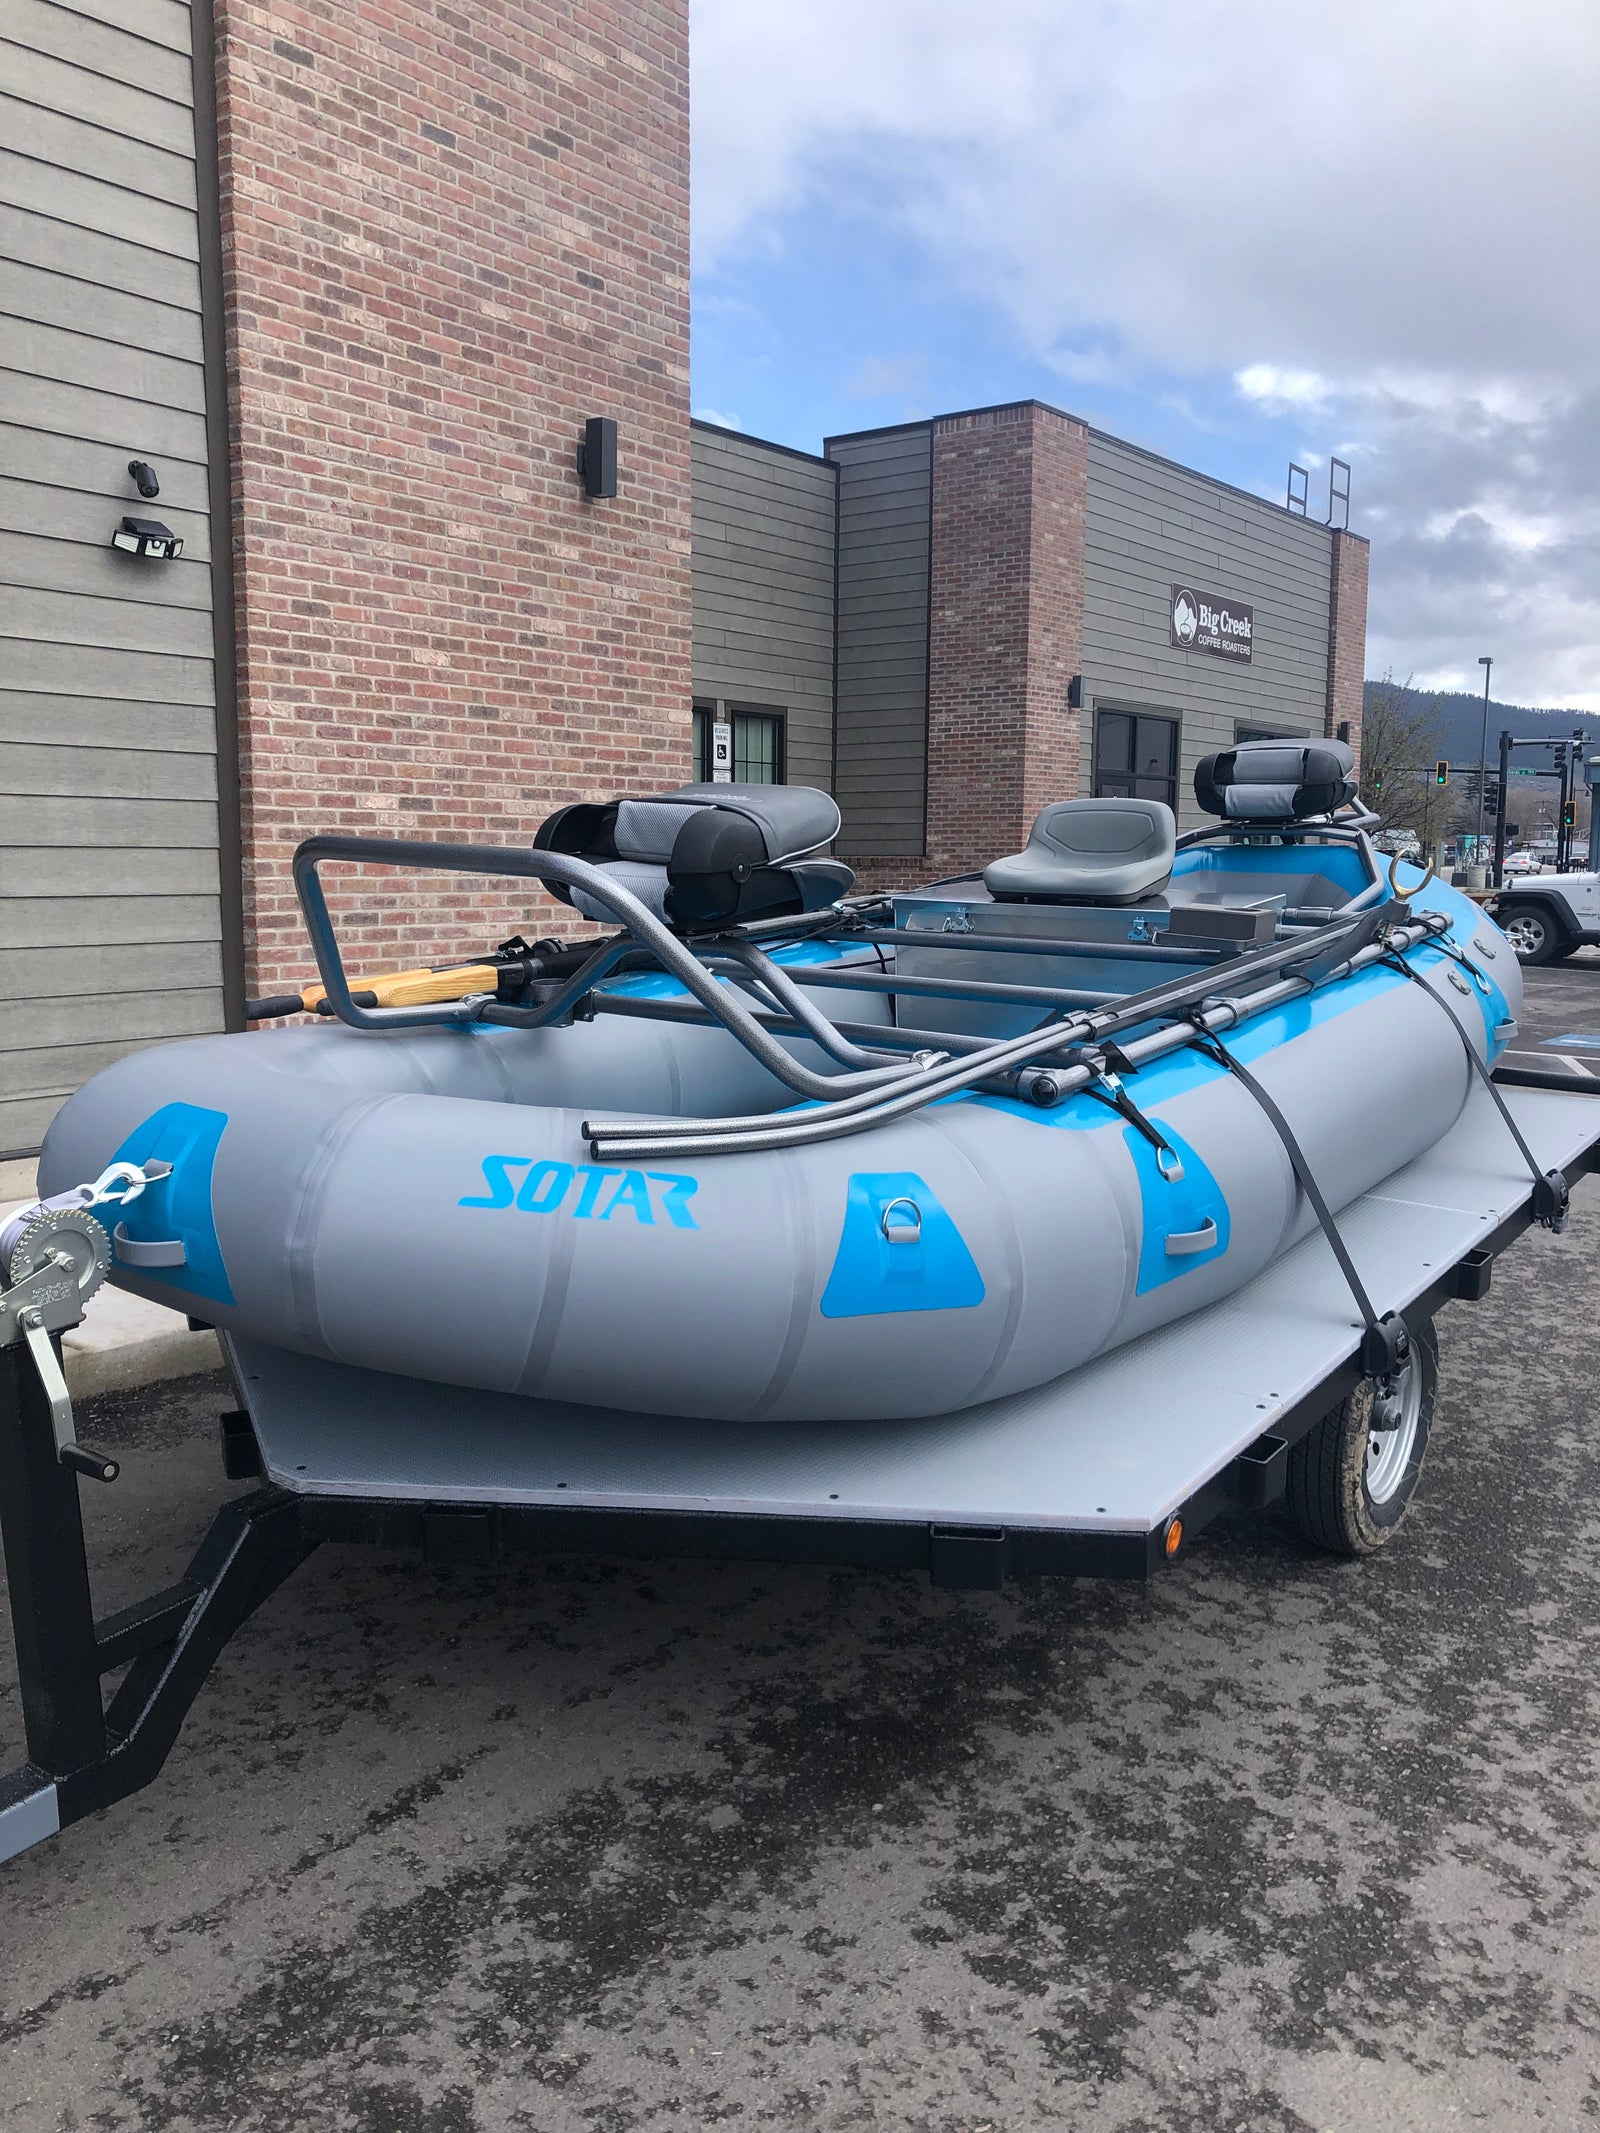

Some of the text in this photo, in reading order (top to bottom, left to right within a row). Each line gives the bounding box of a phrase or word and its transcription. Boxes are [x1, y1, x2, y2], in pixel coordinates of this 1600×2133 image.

[1199, 604, 1252, 638] Big Creek
[1198, 634, 1251, 655] COFFEE ROASTERS
[457, 1155, 700, 1230] SOTAR
